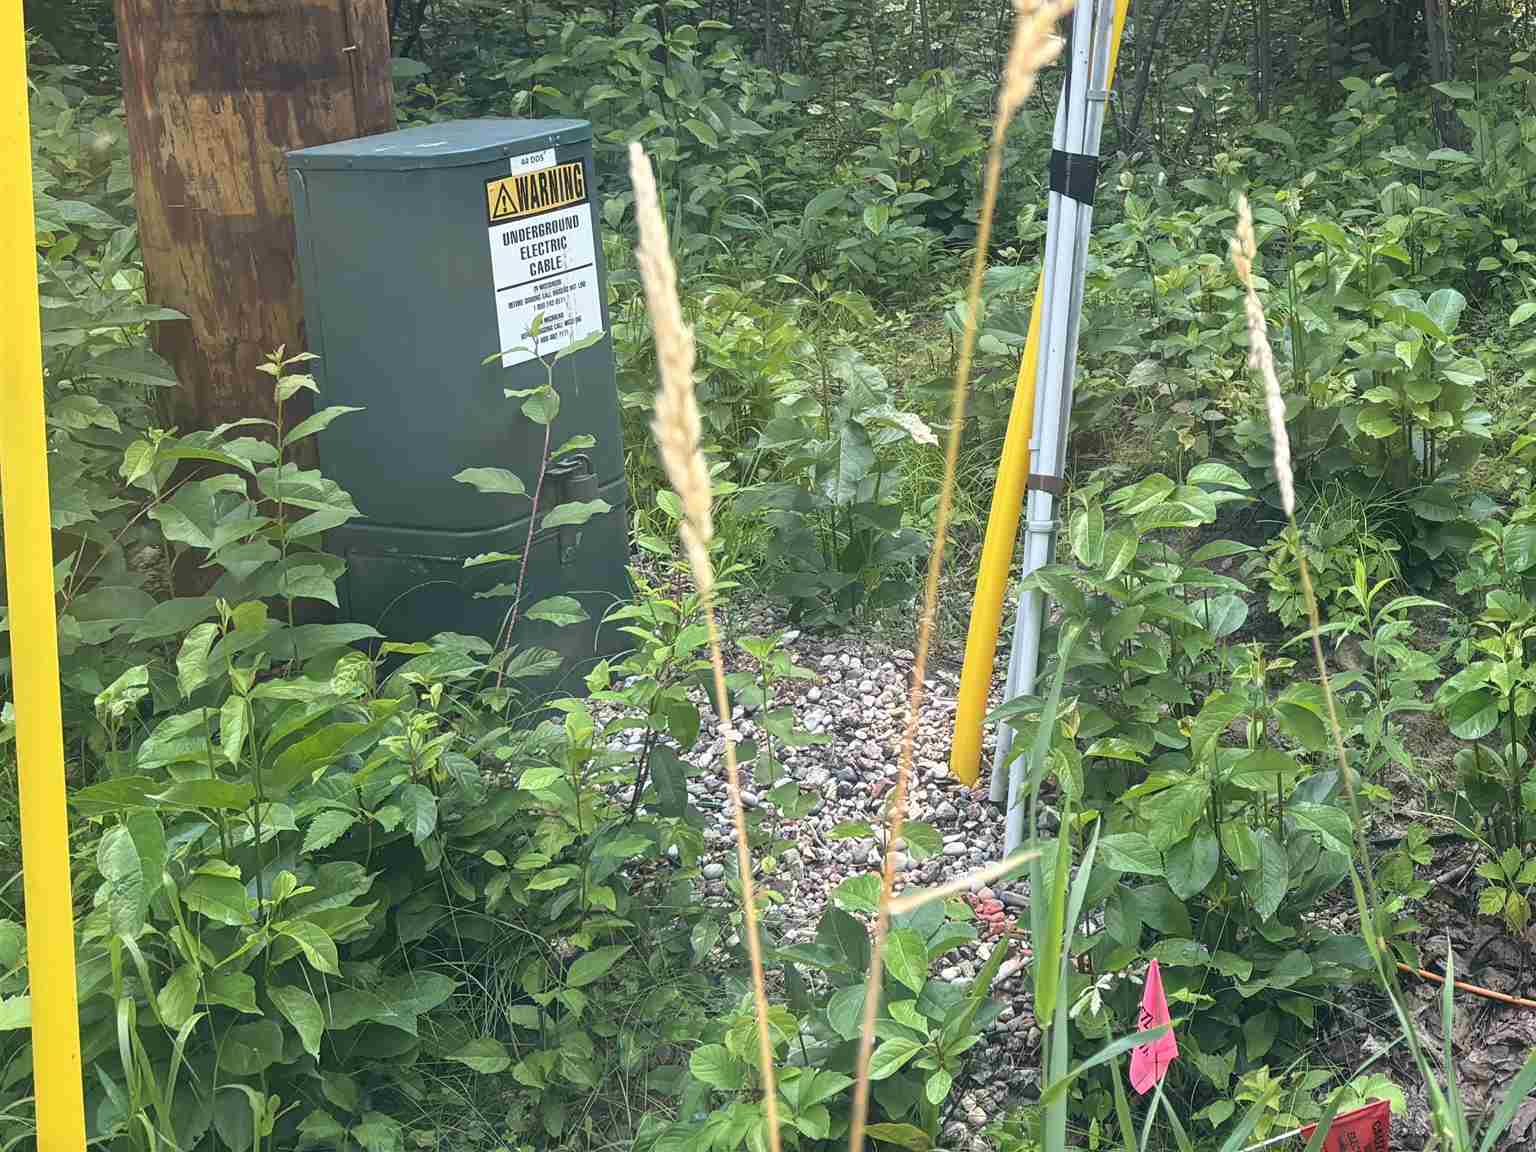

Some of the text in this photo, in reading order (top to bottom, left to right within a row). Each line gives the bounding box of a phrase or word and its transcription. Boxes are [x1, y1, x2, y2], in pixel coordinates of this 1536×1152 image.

[515, 164, 583, 211] WARNING
[502, 215, 579, 246] UNDERGROUND
[520, 236, 568, 261] ELECTRIC
[529, 256, 562, 277] CABLE
